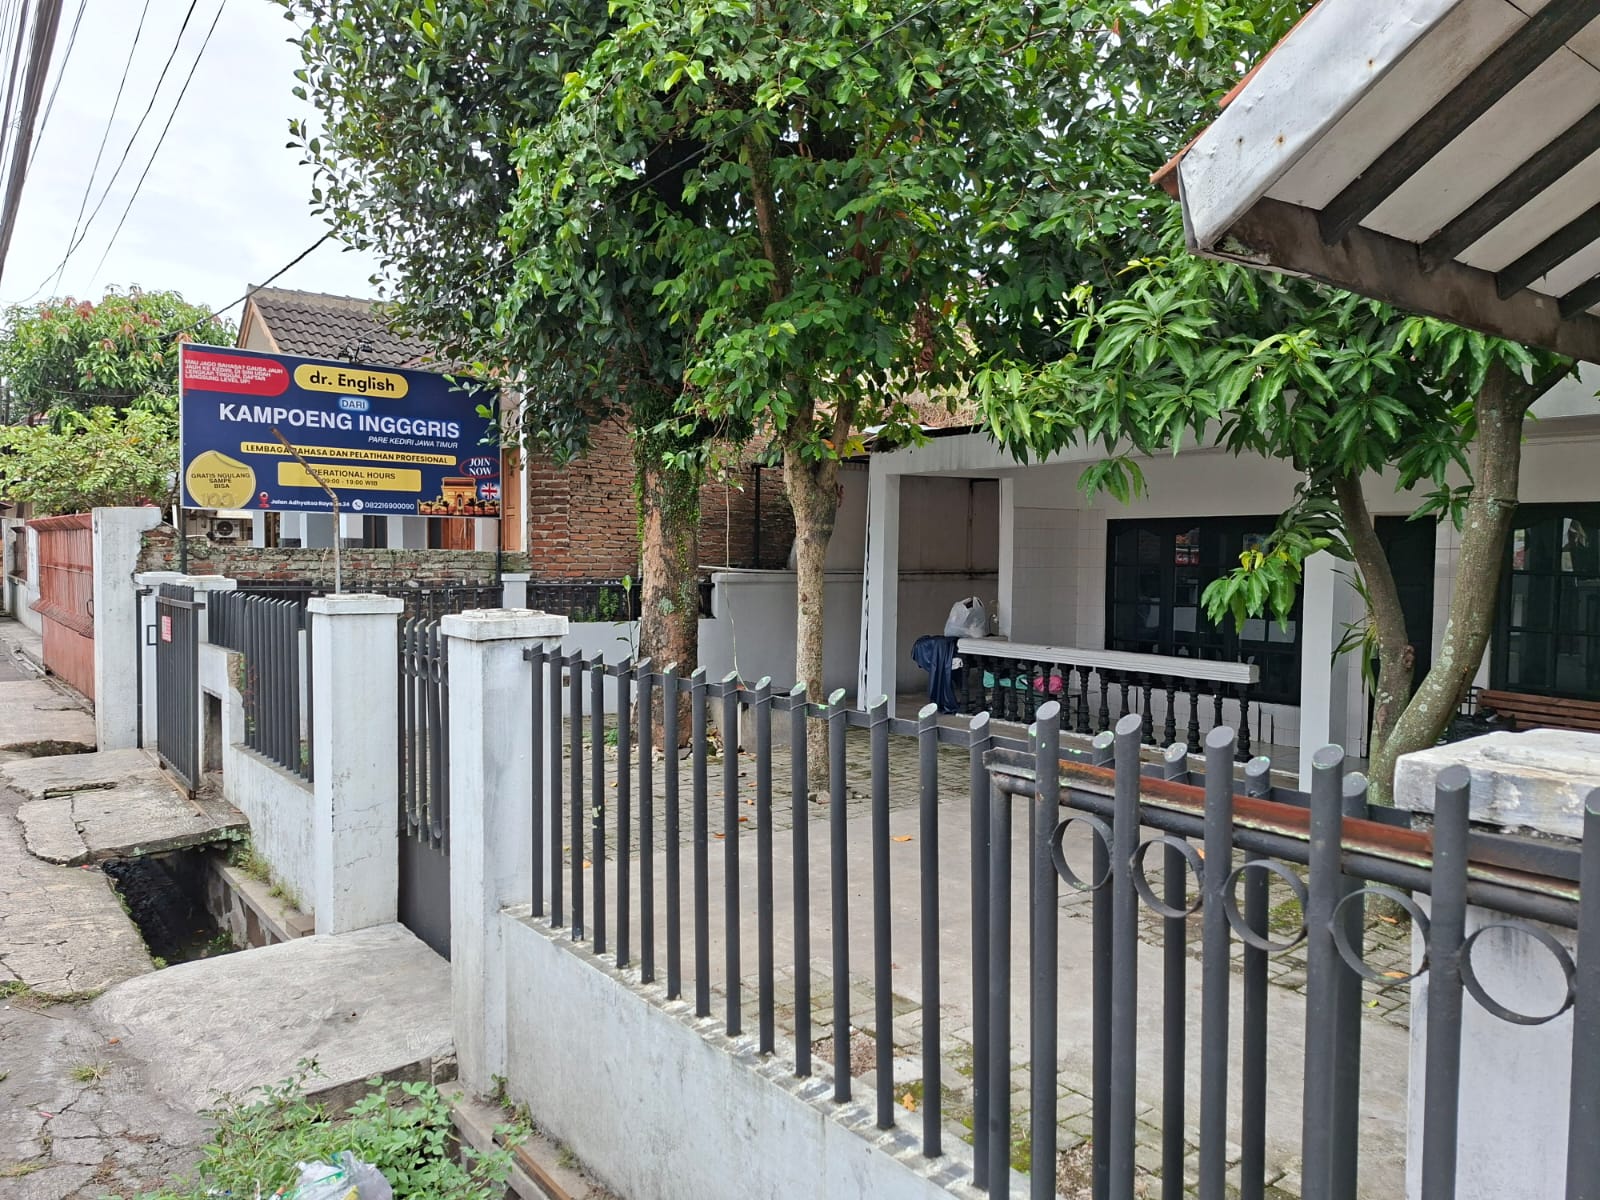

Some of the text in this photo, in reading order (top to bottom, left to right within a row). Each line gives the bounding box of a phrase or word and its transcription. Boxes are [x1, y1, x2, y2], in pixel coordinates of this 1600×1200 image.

[309, 370, 395, 393] dr. English
[341, 400, 366, 409] DARI
[219, 403, 460, 438] KAMPOENG INGGGRIS
[368, 436, 458, 449] PARE KEDIRI JAWA TIMUR
[246, 444, 290, 454] LEMBAGA
[350, 451, 395, 461] PELATIHAN
[396, 454, 448, 464] PROFESIONAL
[469, 457, 490, 466] JOIN
[367, 471, 396, 479] HOURS
[469, 467, 492, 476] NOW
